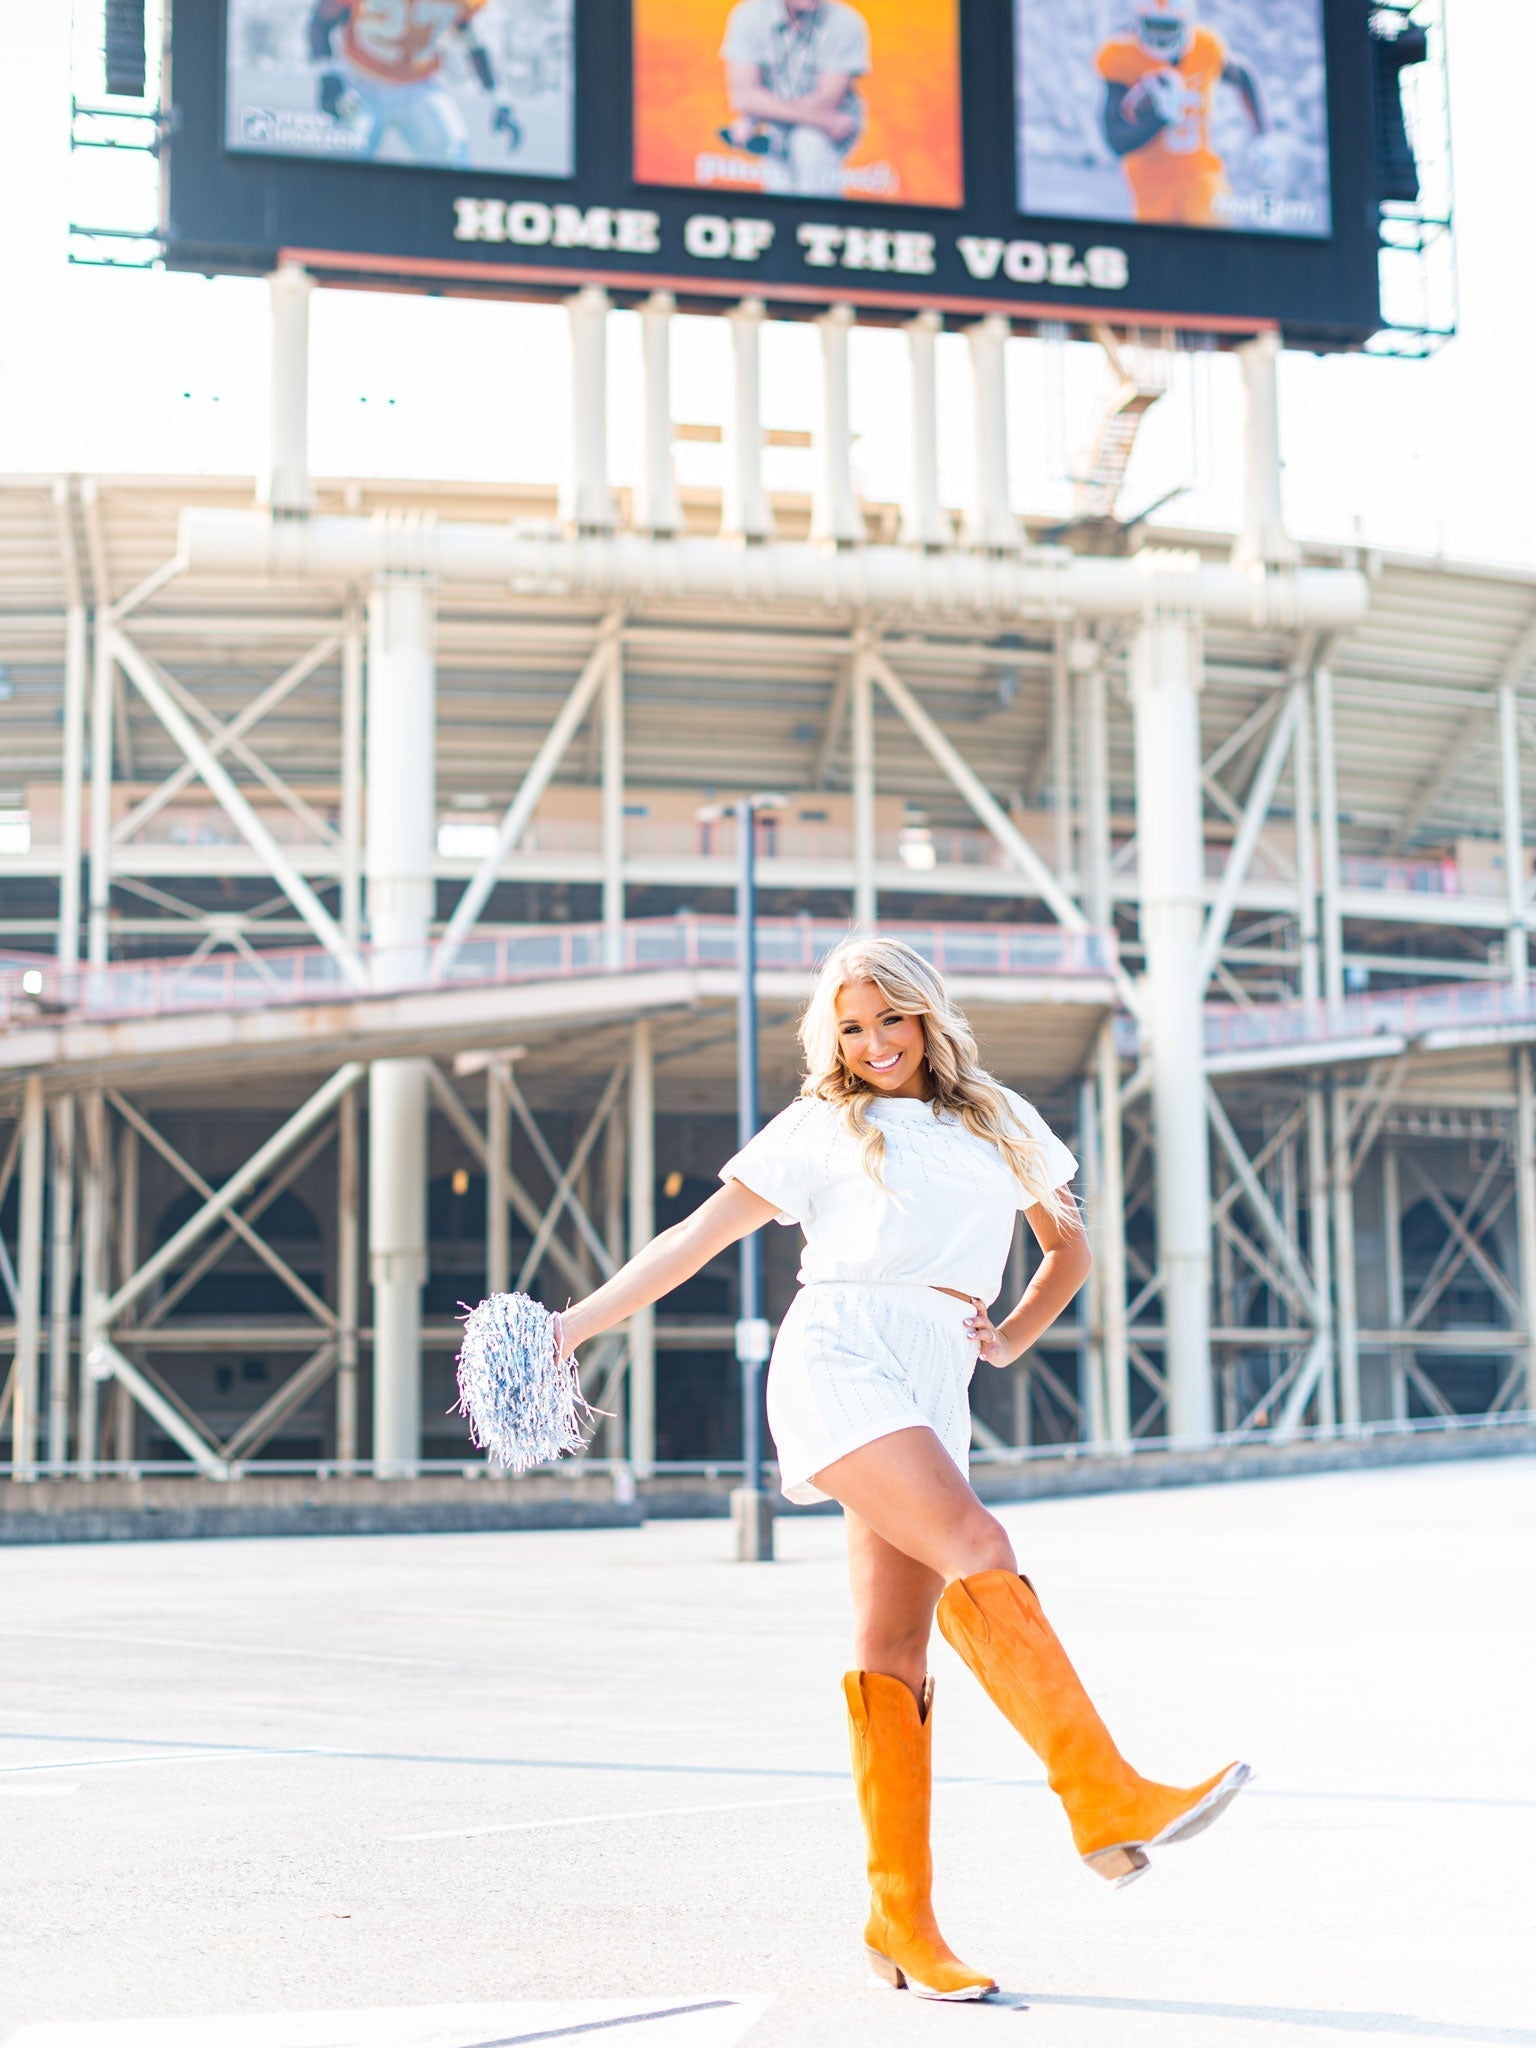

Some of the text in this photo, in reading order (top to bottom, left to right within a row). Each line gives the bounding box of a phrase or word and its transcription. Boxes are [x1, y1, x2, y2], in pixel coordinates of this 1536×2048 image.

[453, 197, 1129, 289] HOME OF THE VOLS
